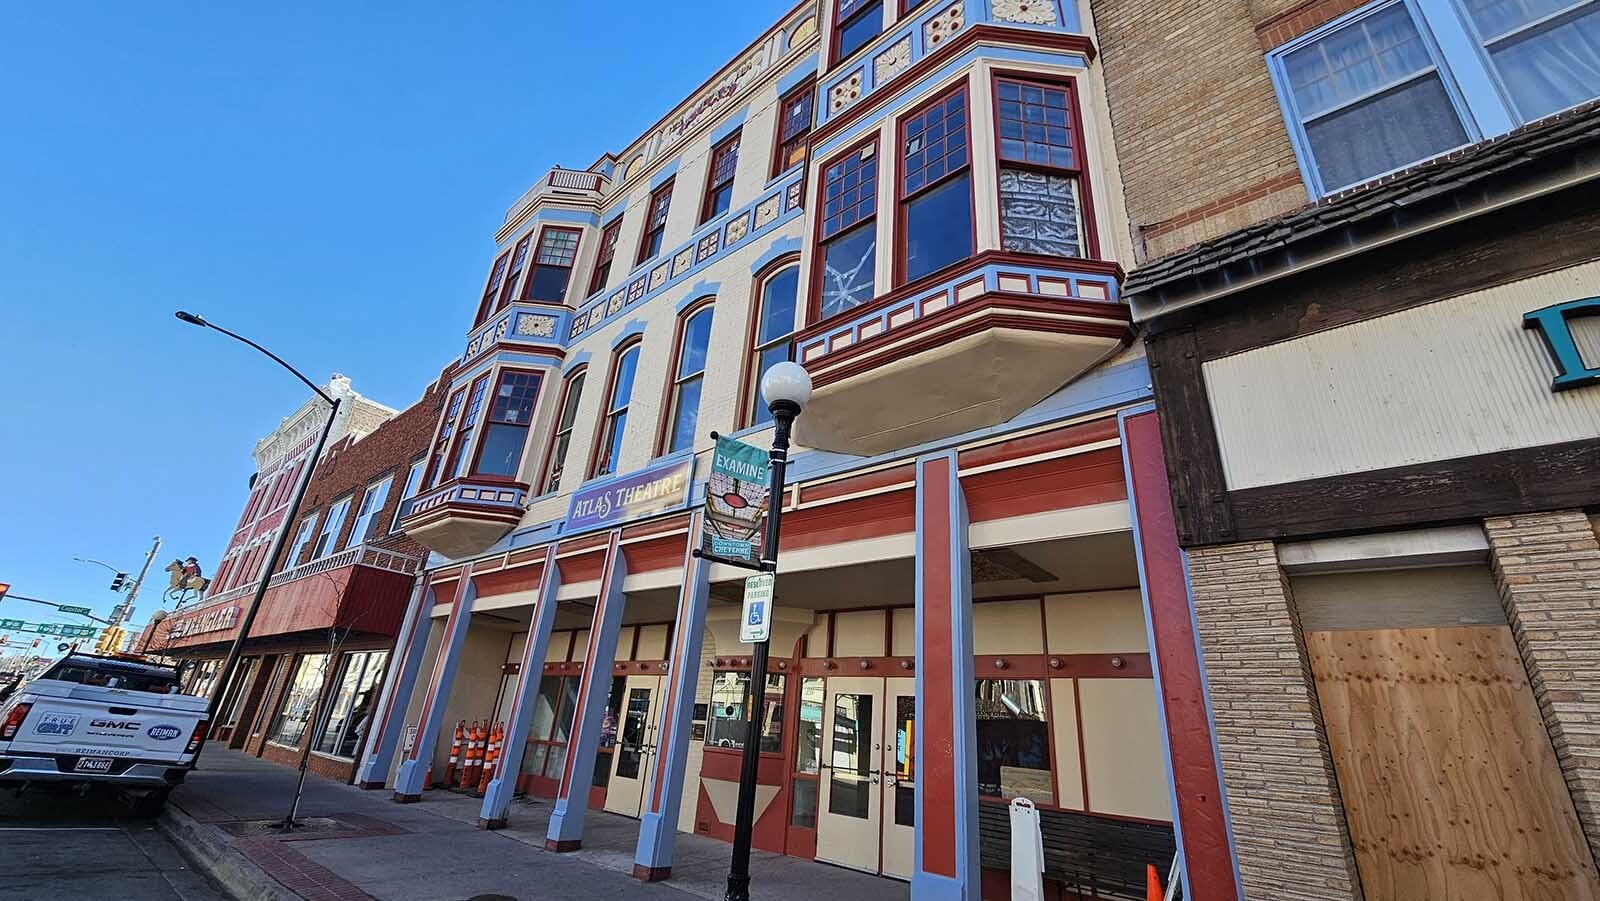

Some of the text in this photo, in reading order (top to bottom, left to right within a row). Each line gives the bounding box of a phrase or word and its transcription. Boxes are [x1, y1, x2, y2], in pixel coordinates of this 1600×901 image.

[715, 453, 764, 480] EXAMINE
[573, 473, 683, 520] ATLAS THEATRE
[714, 540, 749, 548] DOWNTOWN
[714, 546, 749, 555] CHEYENNE
[747, 578, 772, 588] RESERVED
[89, 719, 142, 730] GMC
[150, 727, 179, 738] REIMAN
